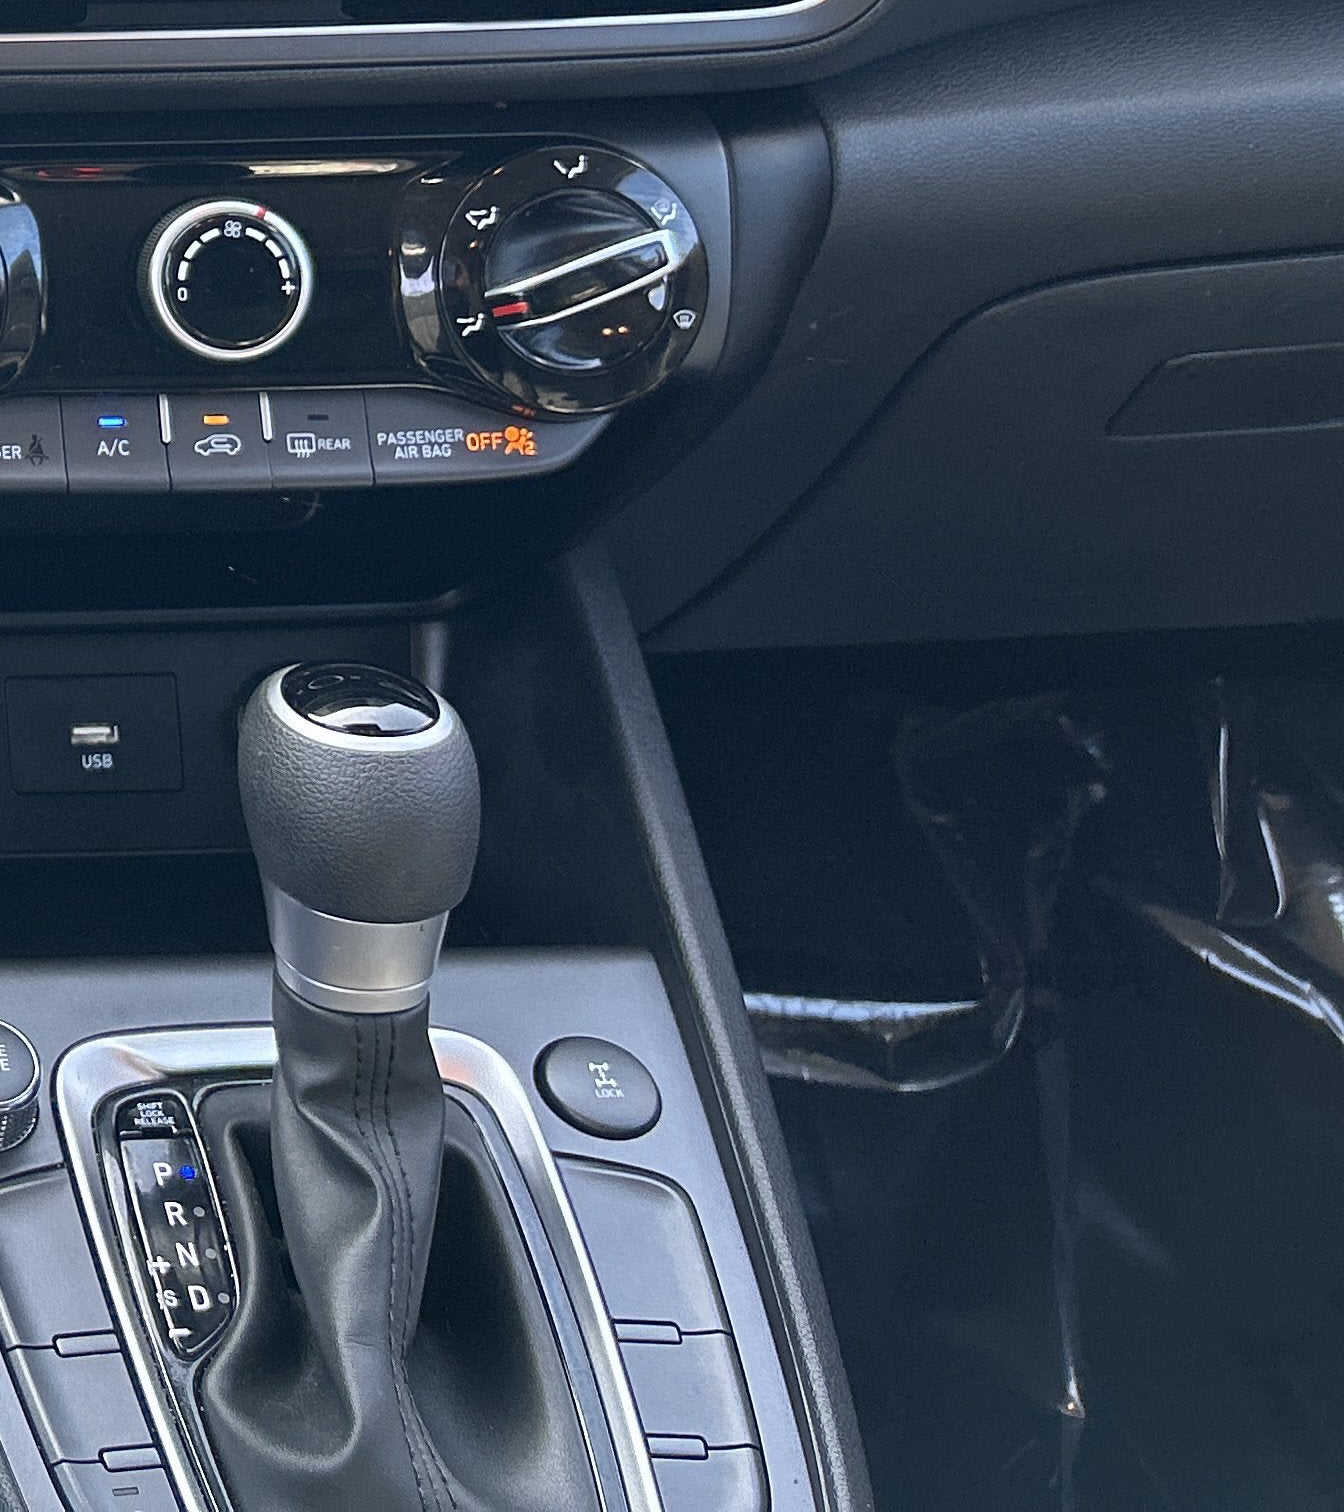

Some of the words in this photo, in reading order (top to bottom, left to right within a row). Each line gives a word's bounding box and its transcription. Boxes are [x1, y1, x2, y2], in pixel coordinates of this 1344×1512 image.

[316, 437, 352, 451] REAR
[376, 428, 464, 446] PASSENGER
[465, 431, 504, 452] OFF
[96, 438, 131, 457] A/C
[394, 445, 419, 460] AIR
[421, 443, 452, 459] BAG
[80, 753, 113, 770] USB
[594, 1088, 625, 1098] LOCK
[136, 1101, 163, 1111] SHIFT
[139, 1109, 165, 1118] LOCK
[133, 1116, 175, 1126] RELEASE
[152, 1162, 173, 1187] P
[163, 1201, 188, 1227] R
[175, 1241, 200, 1267] N
[187, 1284, 211, 1312] D
